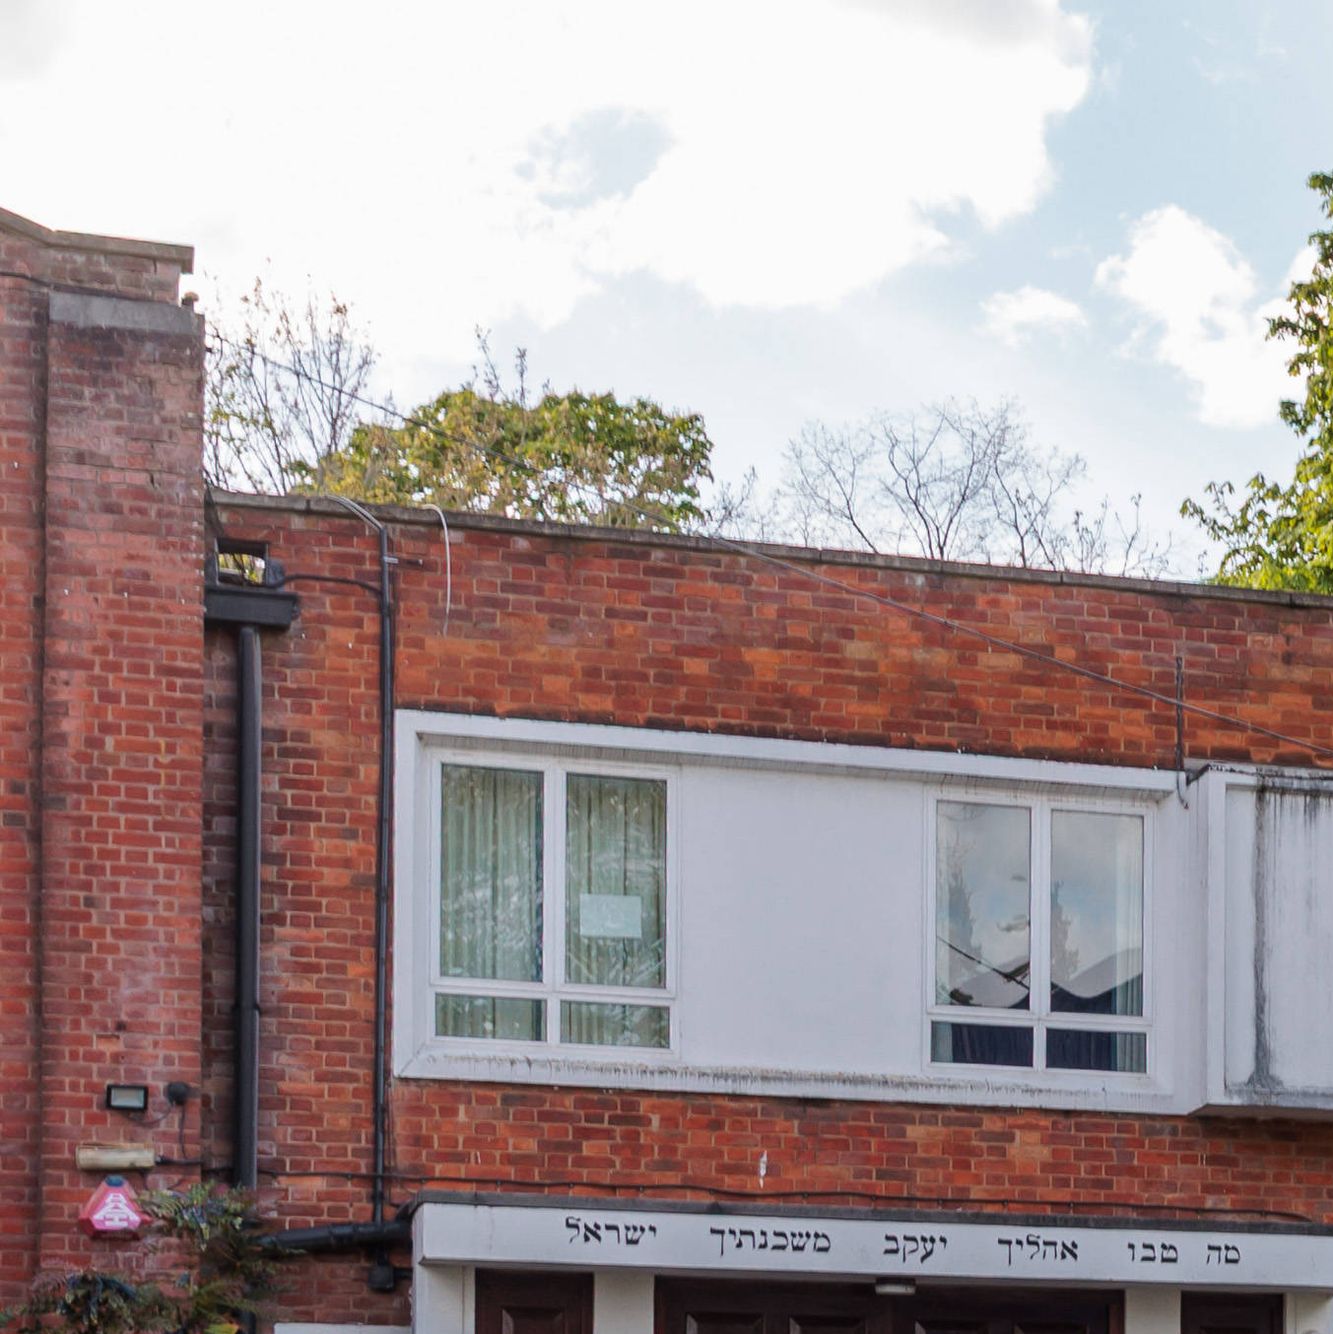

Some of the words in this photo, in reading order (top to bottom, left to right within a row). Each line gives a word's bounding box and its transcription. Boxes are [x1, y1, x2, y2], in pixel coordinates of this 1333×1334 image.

[565, 1217, 657, 1246] ישראל
[710, 1227, 832, 1257] משכנתיך
[884, 1234, 947, 1263] יעקב
[998, 1233, 1078, 1266] אהליך
[1128, 1241, 1179, 1264] טבו
